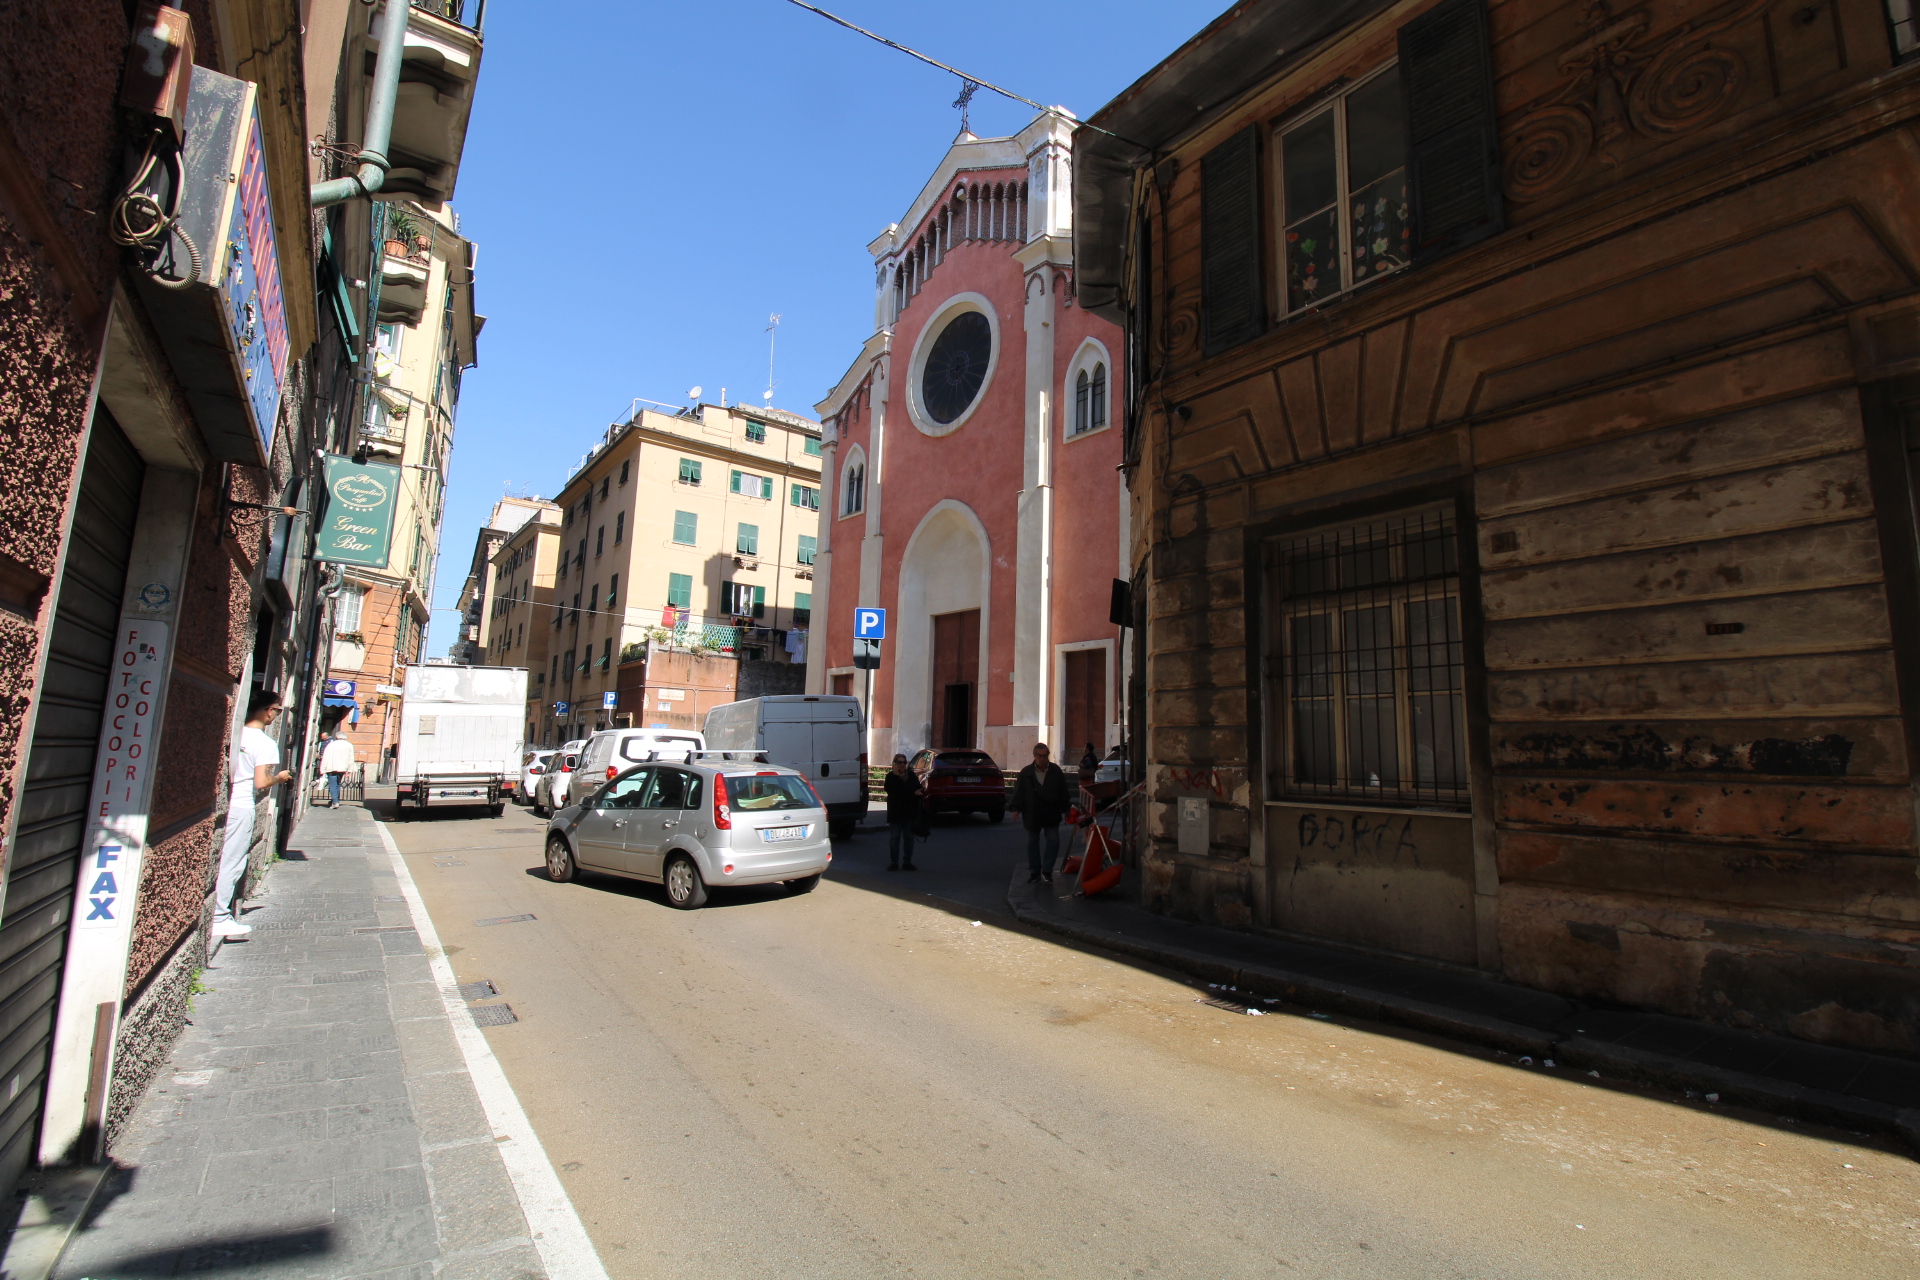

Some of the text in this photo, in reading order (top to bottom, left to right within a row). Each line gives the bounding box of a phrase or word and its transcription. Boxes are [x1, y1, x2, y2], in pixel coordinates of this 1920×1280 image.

[338, 483, 383, 497] Pasqualini
[333, 515, 378, 535] Green
[332, 534, 373, 551] Bar
[861, 612, 879, 635] P
[559, 703, 567, 711] P
[607, 693, 616, 704] P
[847, 709, 854, 718] 3
[99, 631, 138, 817] FOTOCOPIE
[125, 680, 152, 803] COLORI
[86, 846, 122, 920] FAX
